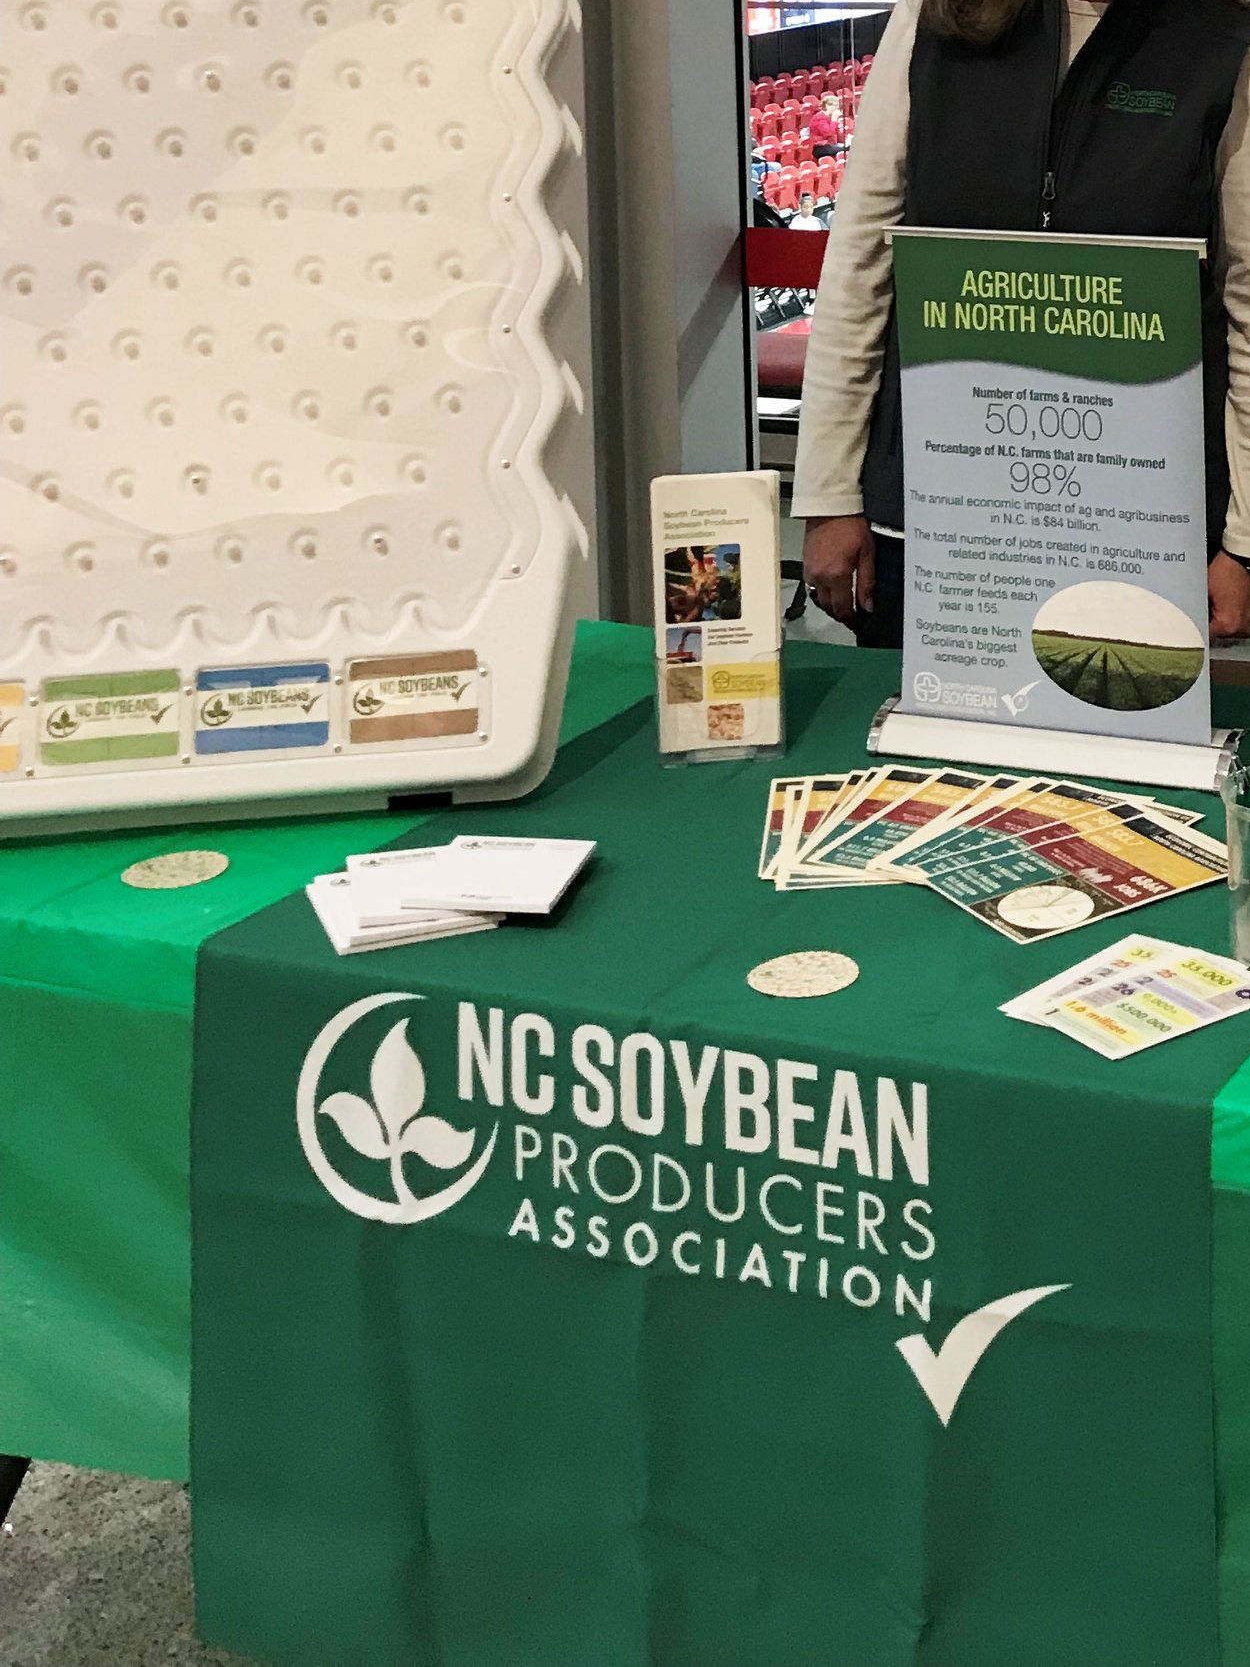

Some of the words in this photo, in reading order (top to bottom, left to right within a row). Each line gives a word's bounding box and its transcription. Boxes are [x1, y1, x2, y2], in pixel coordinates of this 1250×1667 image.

[960, 269, 1124, 306] AGRICULTURE
[923, 300, 947, 329] IN
[954, 303, 1037, 334] NORTH
[1044, 305, 1166, 343] CAROLINA
[972, 386, 1014, 400] Number
[1015, 389, 1028, 401] of
[1029, 390, 1060, 403] farms
[1061, 392, 1070, 404] &
[1072, 394, 1114, 407] ranches
[985, 402, 1103, 442] 50,000
[925, 440, 982, 458] Percentage
[984, 445, 996, 456] of
[997, 445, 1020, 457] N.C.
[1021, 446, 1052, 460] farms
[1053, 449, 1075, 462] that
[1076, 453, 1094, 464] are
[1095, 452, 1128, 469] family
[1129, 457, 1166, 470] owned
[1009, 460, 1082, 498] 98%
[909, 489, 926, 503] The
[928, 495, 964, 507] annual
[966, 497, 1022, 511] economic
[1023, 499, 1063, 513] impact
[1064, 503, 1076, 514] of
[1078, 505, 1092, 519] ag
[1094, 506, 1116, 519] and
[1118, 508, 1191, 525] agribusiness
[990, 513, 1000, 524] in
[1002, 513, 1028, 526] N.C.
[1031, 515, 1041, 527] is
[1042, 514, 1064, 529] $84
[1066, 518, 1102, 532] billion.
[914, 527, 931, 541] The
[933, 531, 957, 544] total
[959, 534, 1003, 547] number
[1005, 536, 1017, 548] of
[1018, 538, 1043, 551] jobs
[1045, 540, 1087, 554] created
[1090, 544, 1100, 555] in
[1102, 546, 1161, 561] agriculture
[1163, 551, 1186, 563] and
[948, 548, 986, 561] related
[988, 550, 1043, 565] industries
[1045, 555, 1056, 566] in
[1058, 555, 1082, 569] N.C.
[1085, 558, 1096, 570] is
[1097, 559, 1144, 576] 686,000.
[914, 565, 934, 579] The
[934, 569, 978, 583] number
[979, 572, 991, 583] of
[993, 574, 1032, 588] people
[1034, 578, 1057, 589] one
[938, 584, 974, 597] farmer
[977, 586, 1009, 601] feeds
[1010, 591, 1039, 603] each
[938, 601, 962, 613] year
[964, 601, 975, 612] is
[915, 618, 970, 634] Soybeans
[971, 626, 989, 636] are
[991, 625, 1023, 639] North
[920, 634, 975, 651] Carolina's
[976, 640, 1018, 655] biggest
[934, 652, 978, 667] acreage
[980, 656, 1009, 669] crop.
[379, 680, 397, 696] NC
[397, 676, 459, 694] SOYBEANS
[75, 702, 92, 718] NC
[95, 697, 160, 716] SOYBEANS
[228, 692, 245, 707] NC
[246, 688, 310, 706] SOYBEANS
[942, 690, 998, 709] SOYBEAN
[1113, 883, 1142, 899] JOBS
[1111, 982, 1136, 997] 26
[1085, 1010, 1129, 1036] million
[456, 1000, 556, 1117] NC
[571, 1023, 931, 1187] SOYBEAN
[513, 1122, 937, 1264] PRODUCERS
[508, 1197, 934, 1325] ASSOCIATION
